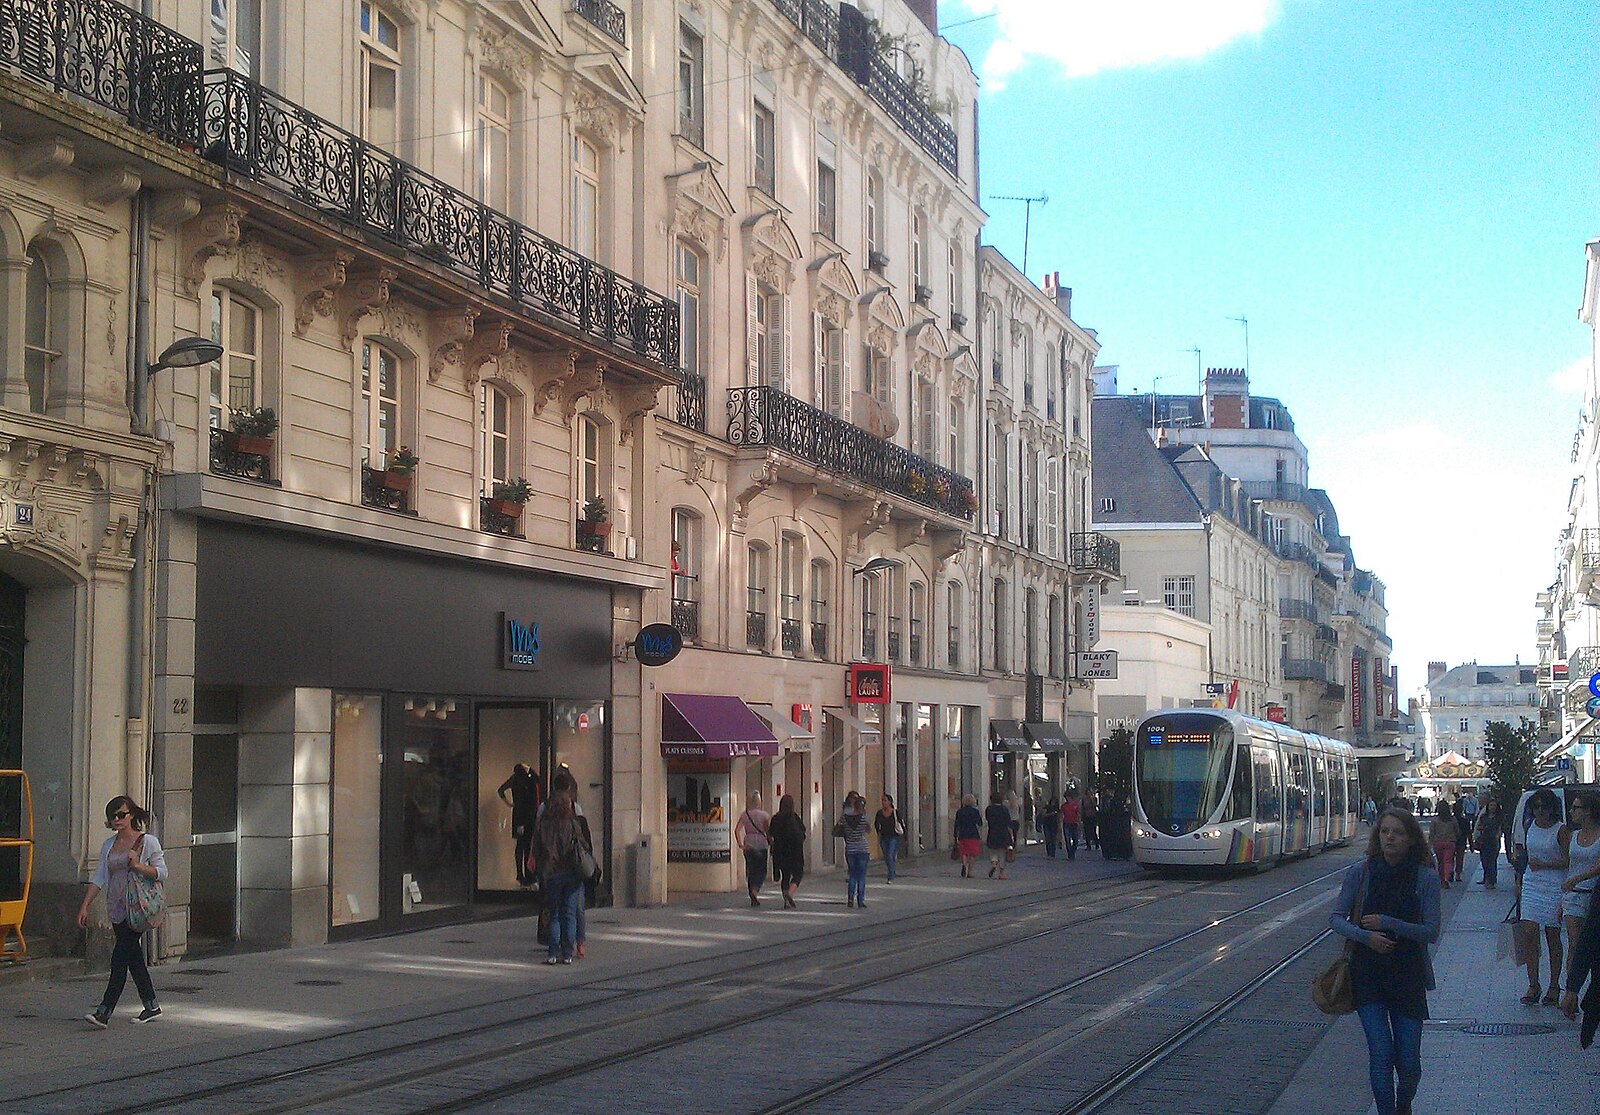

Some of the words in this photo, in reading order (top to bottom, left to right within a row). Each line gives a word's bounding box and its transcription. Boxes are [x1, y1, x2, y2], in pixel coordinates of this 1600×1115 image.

[18, 507, 32, 522] 24
[512, 654, 533, 665] mode
[1082, 653, 1111, 661] BLAKY
[1082, 669, 1111, 677] JONES
[172, 698, 189, 714] 22
